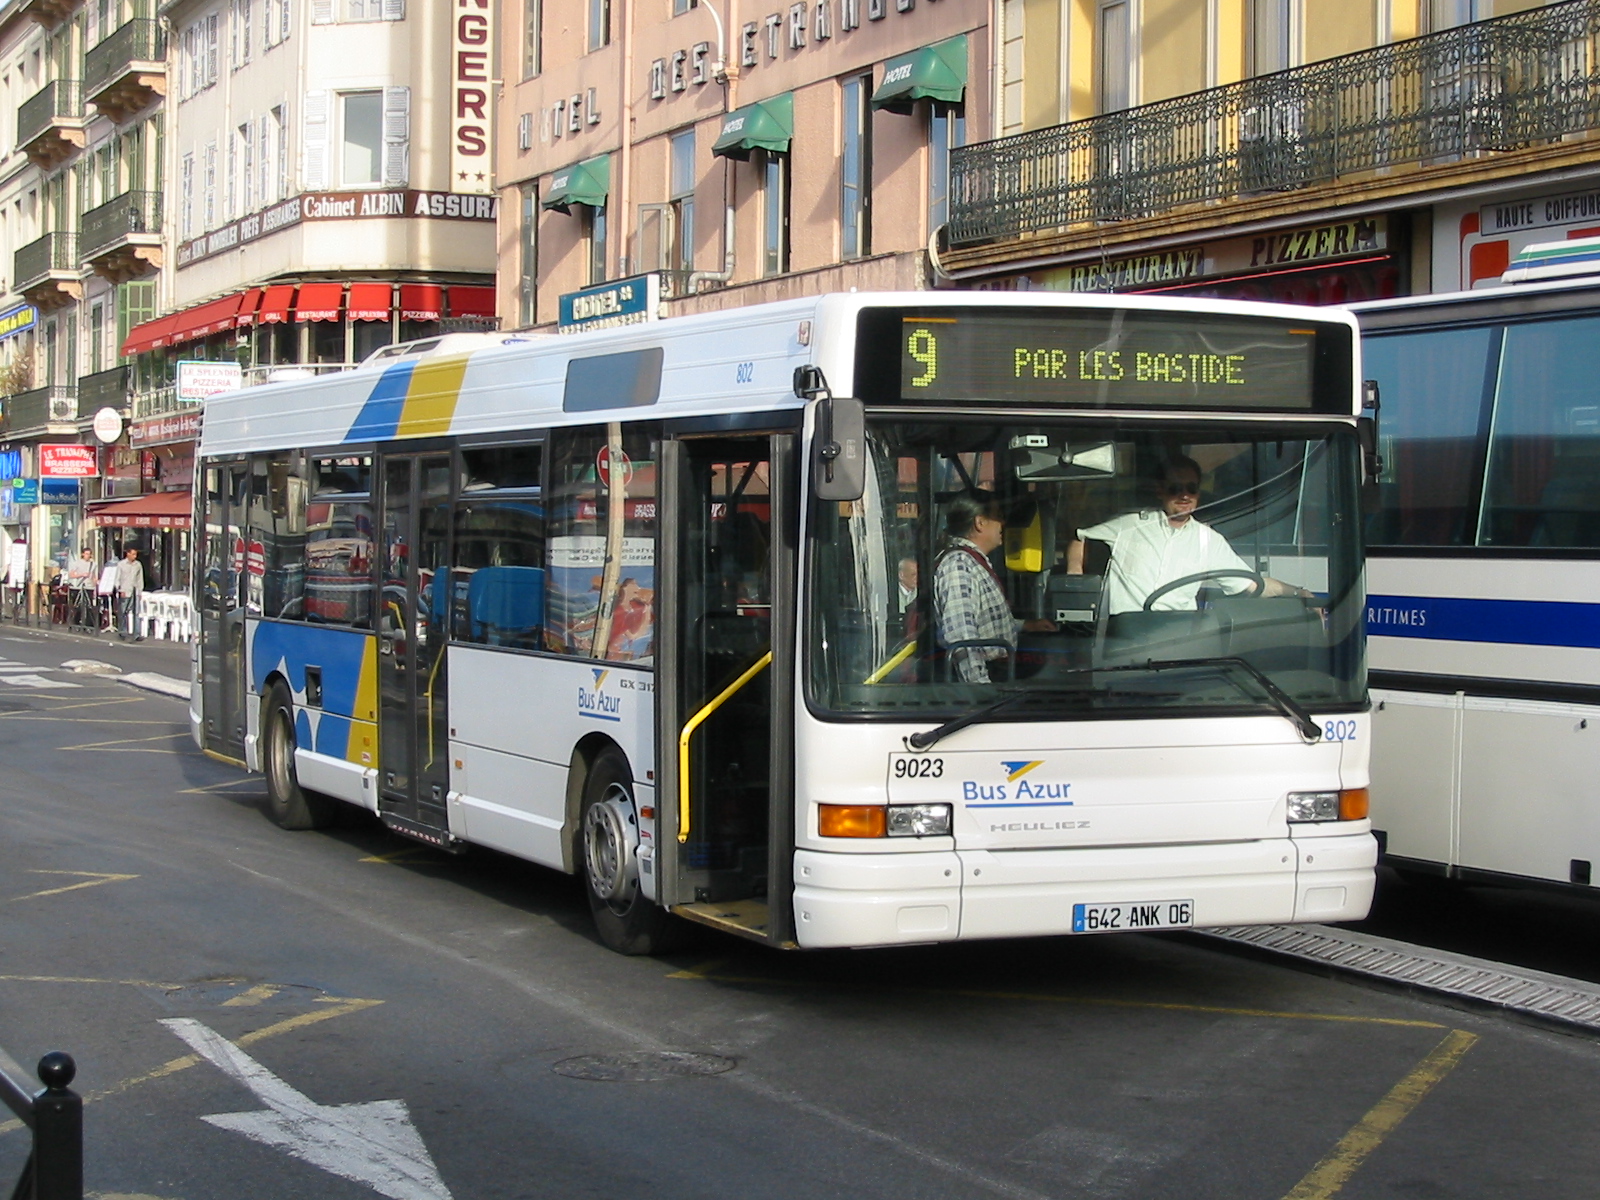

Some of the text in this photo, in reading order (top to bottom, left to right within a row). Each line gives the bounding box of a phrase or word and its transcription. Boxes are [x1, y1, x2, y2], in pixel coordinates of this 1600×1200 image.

[652, 41, 709, 100] DES
[883, 63, 913, 85] HOTEL
[722, 117, 745, 135] HOTEL
[303, 196, 356, 218] Cabinet
[360, 193, 405, 216] ALBIN
[1496, 204, 1533, 229] HAUTE
[1071, 249, 1204, 292] RESTAURANT
[1250, 219, 1378, 267] PIZZERIA
[297, 311, 338, 319] RESTAURANT
[402, 311, 440, 319] PIZZERIA
[908, 329, 1245, 387] 9 PAR LES BASTIDE
[192, 378, 231, 386] PIZZERIA
[197, 368, 239, 377] SPLENDID
[736, 361, 754, 384] 802
[1367, 607, 1427, 627] RITIMES
[620, 679, 635, 689] GX
[578, 687, 621, 714] Bus Azur
[1324, 719, 1357, 741] 802
[894, 758, 944, 778] 9023
[962, 780, 1072, 801] Bus Azur
[990, 820, 1092, 832] HEULIEZ
[1088, 908, 1121, 929] 642
[1129, 905, 1161, 927] ANK
[1169, 903, 1190, 924] 06
